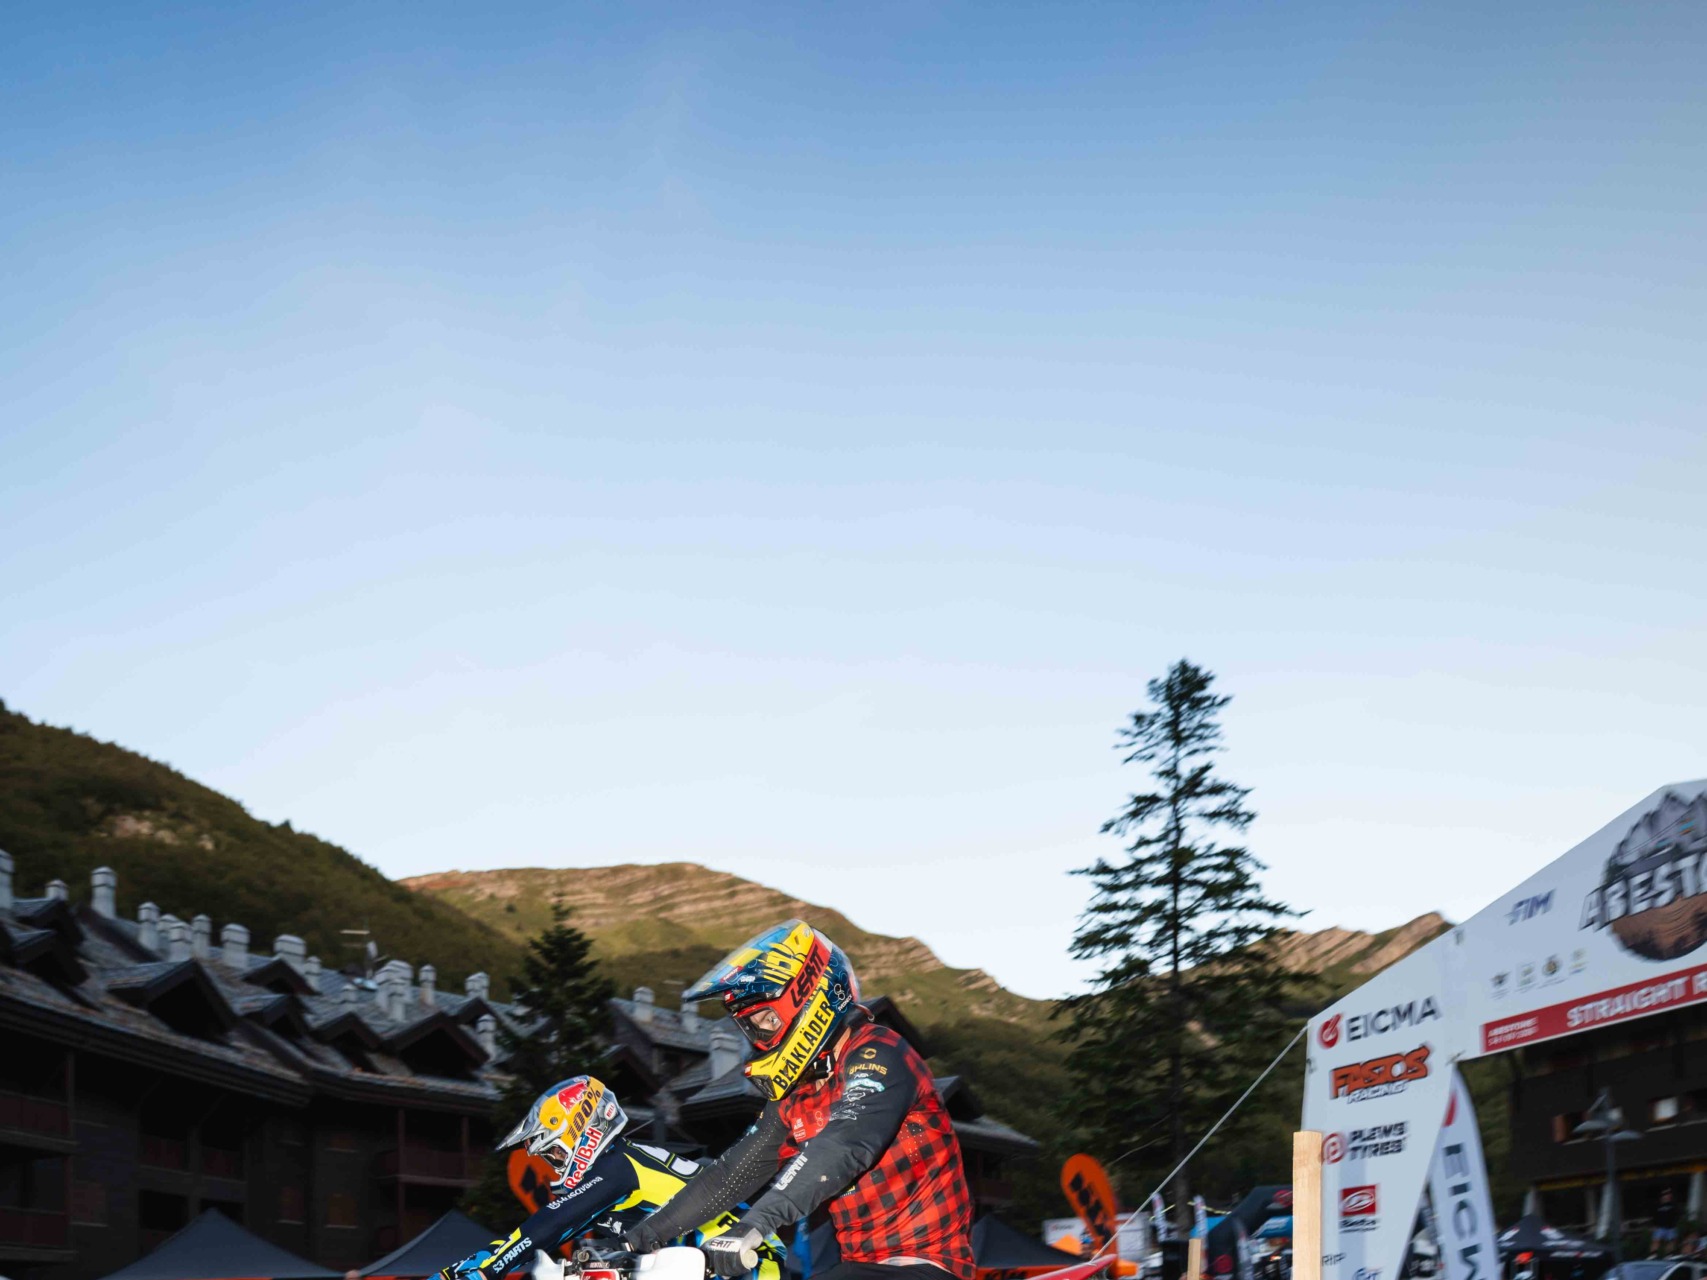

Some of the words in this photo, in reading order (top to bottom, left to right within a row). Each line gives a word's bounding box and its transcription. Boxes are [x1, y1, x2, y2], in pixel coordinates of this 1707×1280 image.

[1578, 850, 1707, 932] ABEST
[790, 944, 825, 1009] LEATT
[1566, 976, 1689, 1028] STRAIGHT
[1346, 995, 1442, 1042] EICMA
[772, 999, 835, 1091] BLÅKLÄDER
[567, 1083, 602, 1143] 100%
[1348, 1120, 1409, 1144] PLEWS
[503, 1237, 533, 1267] PARTS
[709, 1239, 736, 1249] EATT
